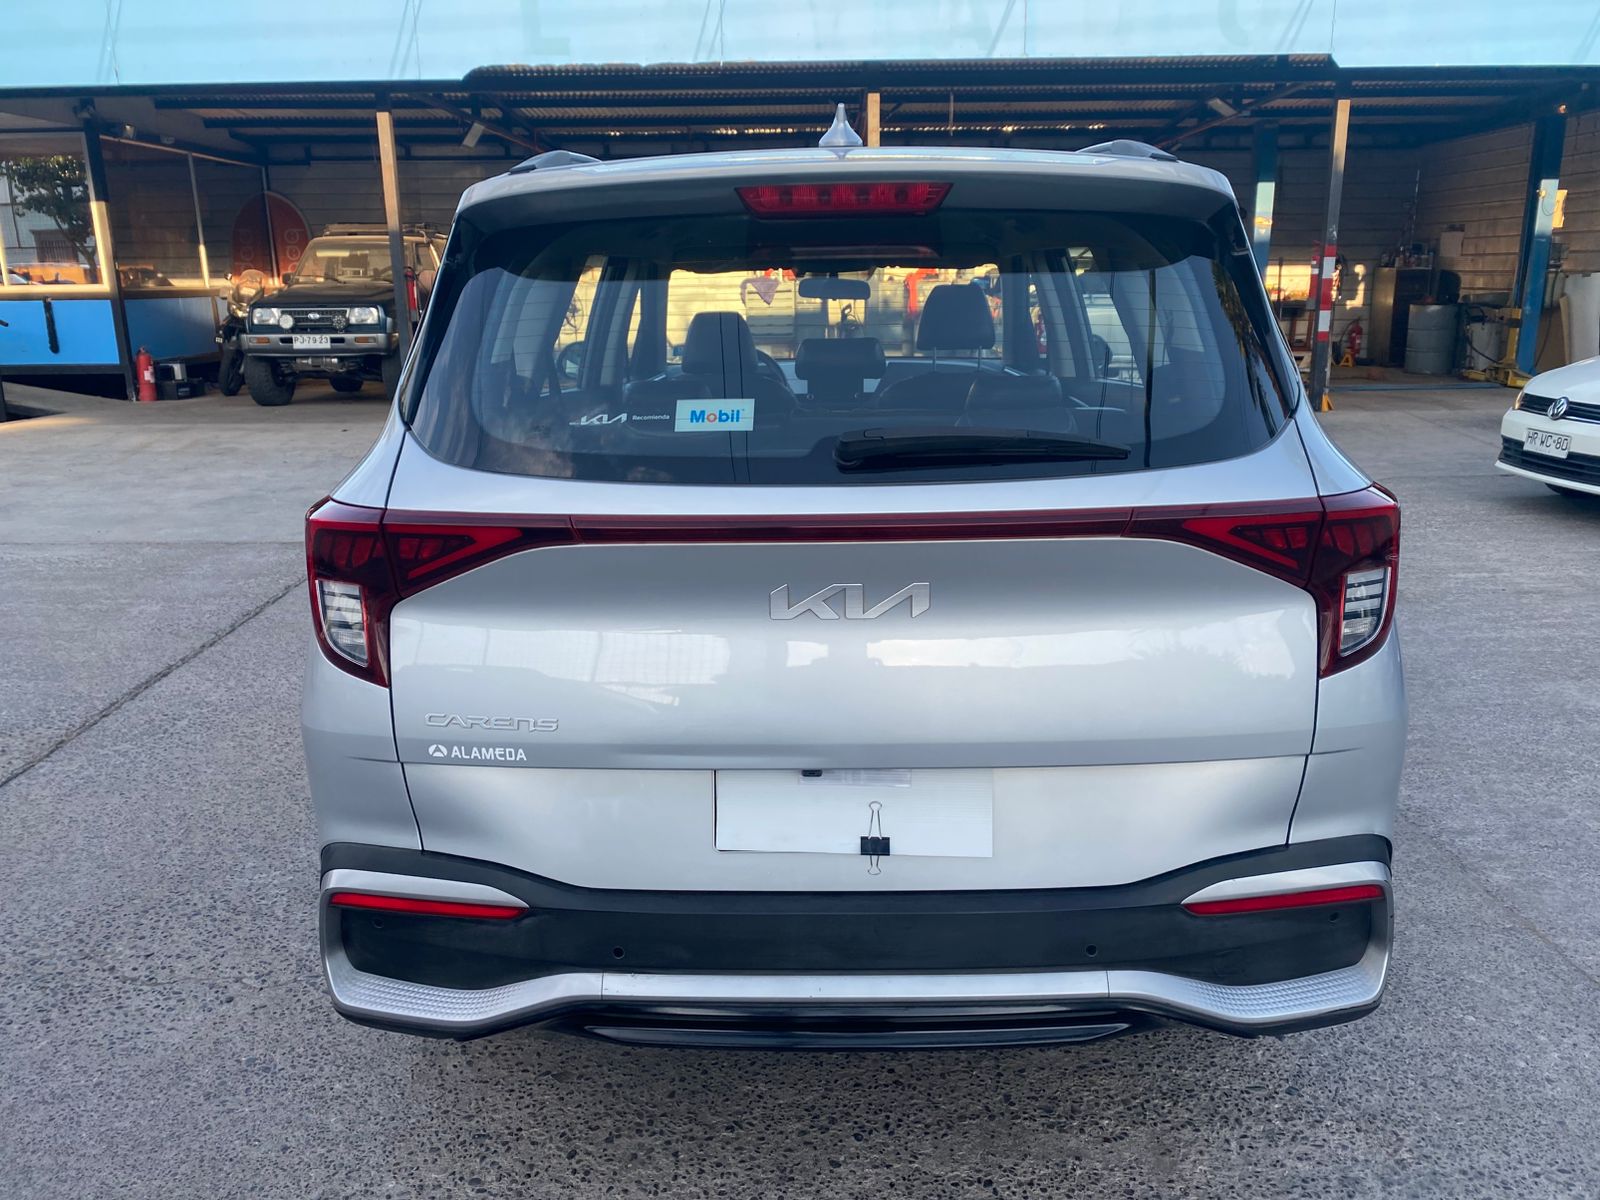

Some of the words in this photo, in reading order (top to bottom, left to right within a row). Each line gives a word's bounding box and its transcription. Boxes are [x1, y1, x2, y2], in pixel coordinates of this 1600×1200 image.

[580, 413, 628, 426] KIA
[690, 409, 740, 423] Mobil
[769, 582, 931, 620] KIA
[424, 712, 559, 732] CARENS
[450, 745, 527, 761] ALAMEDA
